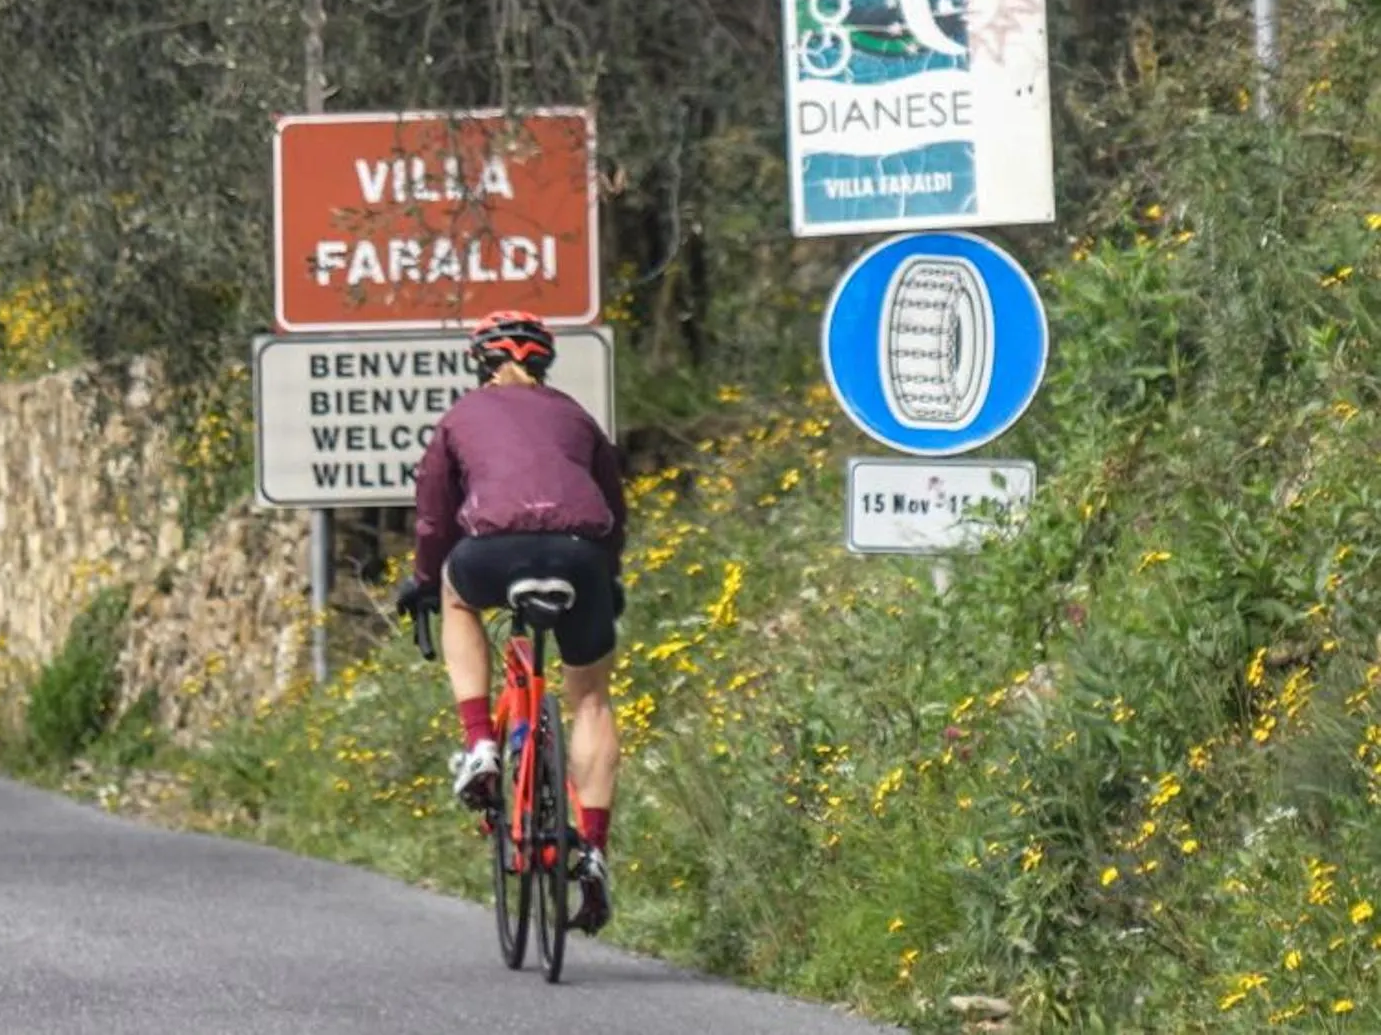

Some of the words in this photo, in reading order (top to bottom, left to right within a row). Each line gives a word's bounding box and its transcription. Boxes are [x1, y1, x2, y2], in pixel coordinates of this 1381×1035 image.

[799, 90, 973, 135] DIANESE
[355, 155, 514, 203] VILLA
[824, 175, 875, 200] VILLA
[316, 235, 557, 286] FARALDI
[863, 493, 886, 514] 15
[893, 492, 930, 515] Nov
